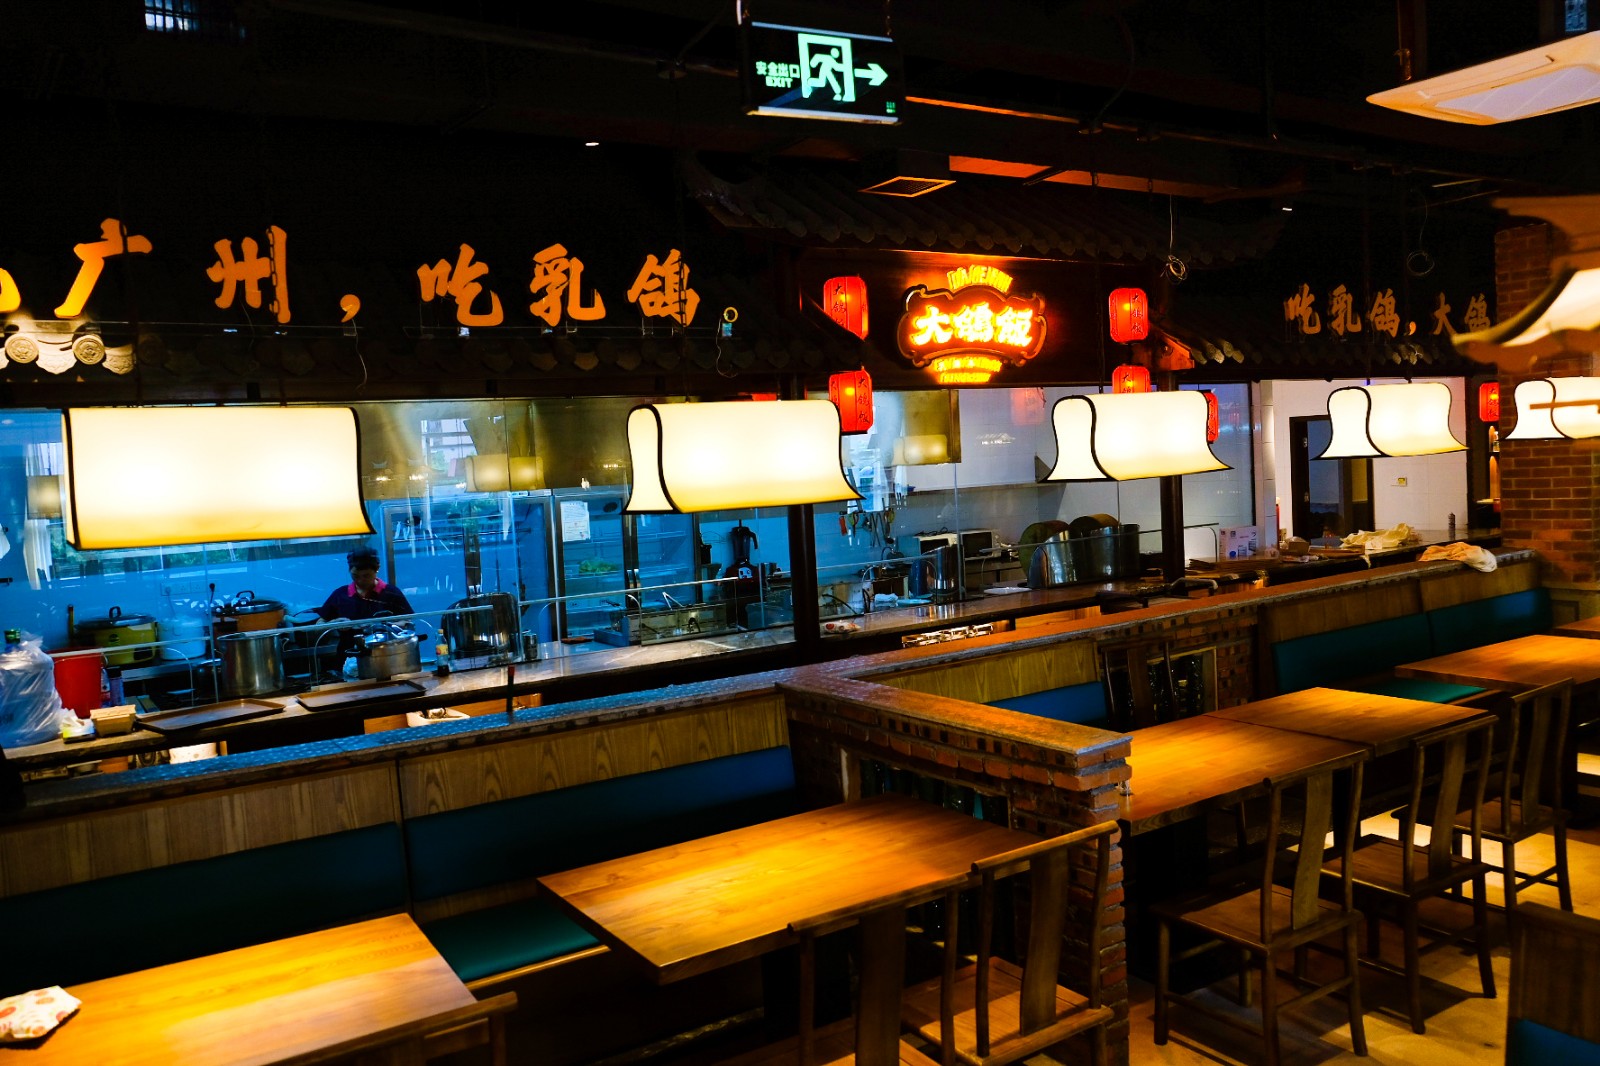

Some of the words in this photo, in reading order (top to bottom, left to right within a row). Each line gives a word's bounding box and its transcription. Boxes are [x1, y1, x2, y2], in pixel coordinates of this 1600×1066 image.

[755, 61, 800, 79] 安全出口
[765, 75, 793, 89] EXIT
[909, 301, 1034, 347] 大鸽饭
